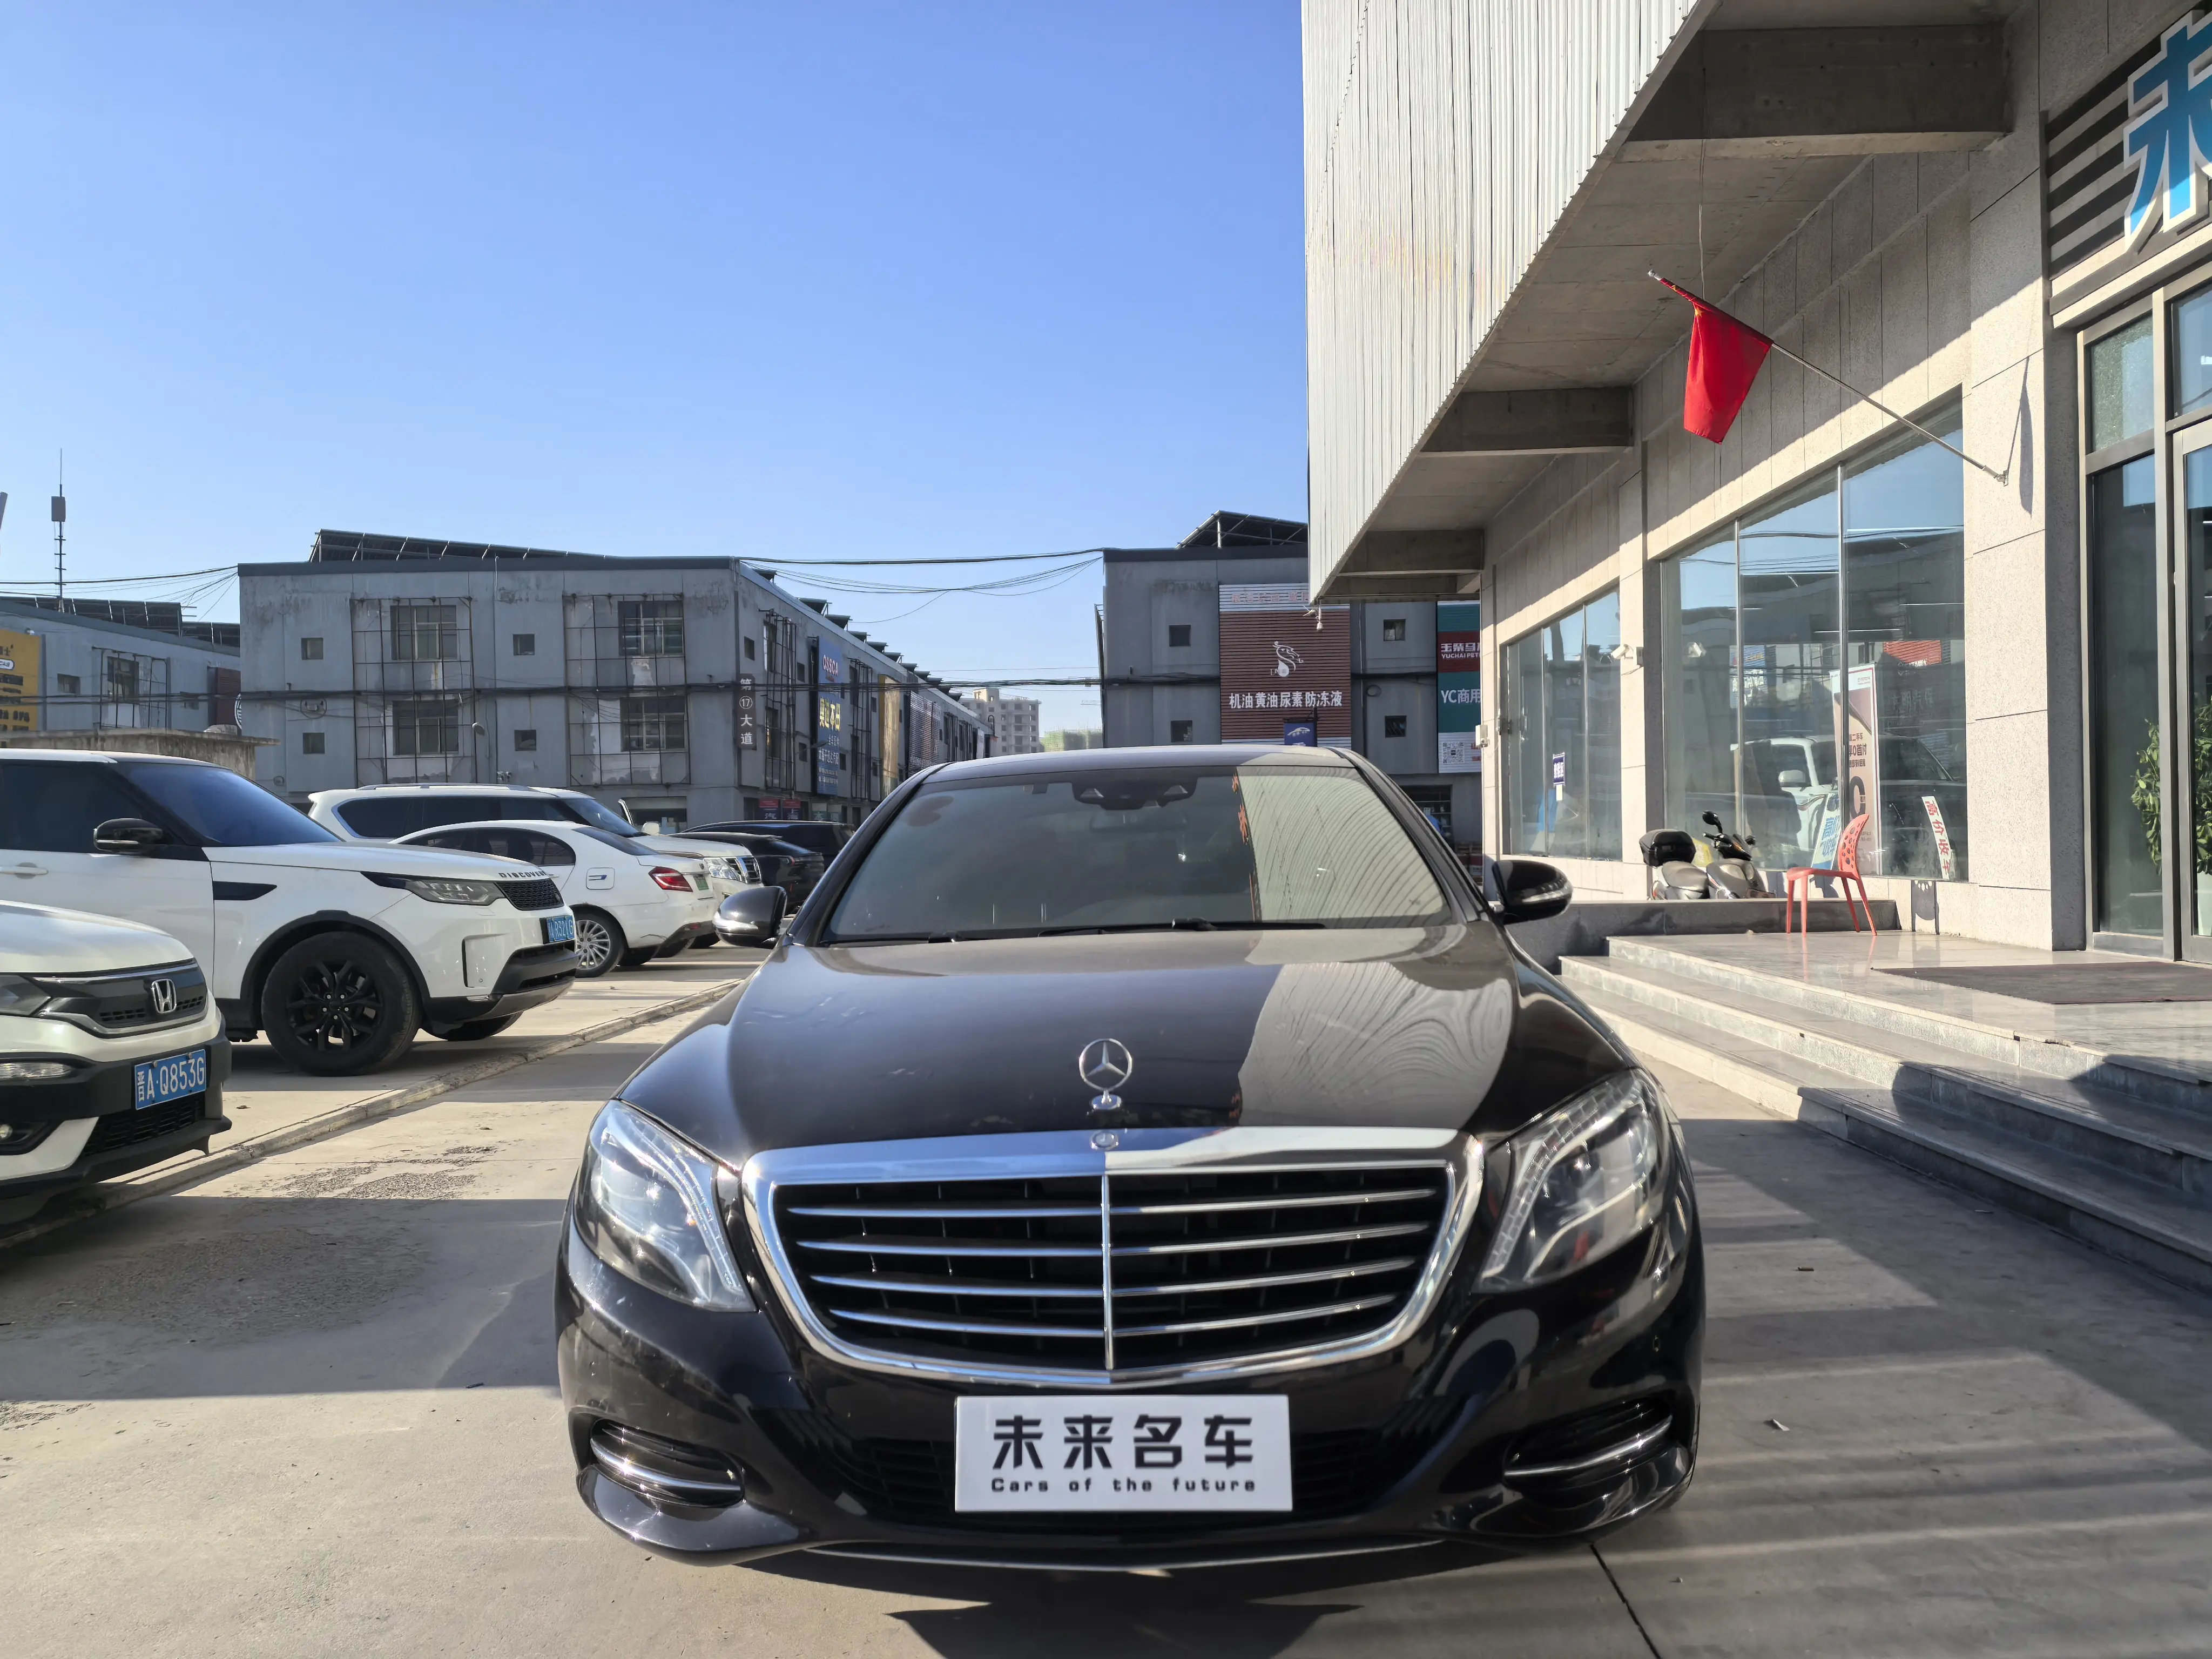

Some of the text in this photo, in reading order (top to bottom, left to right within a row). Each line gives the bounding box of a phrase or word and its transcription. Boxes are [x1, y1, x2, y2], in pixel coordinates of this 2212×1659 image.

[993, 1414, 1253, 1471] 未来名车
[992, 1477, 1256, 1492] Cars of the future
